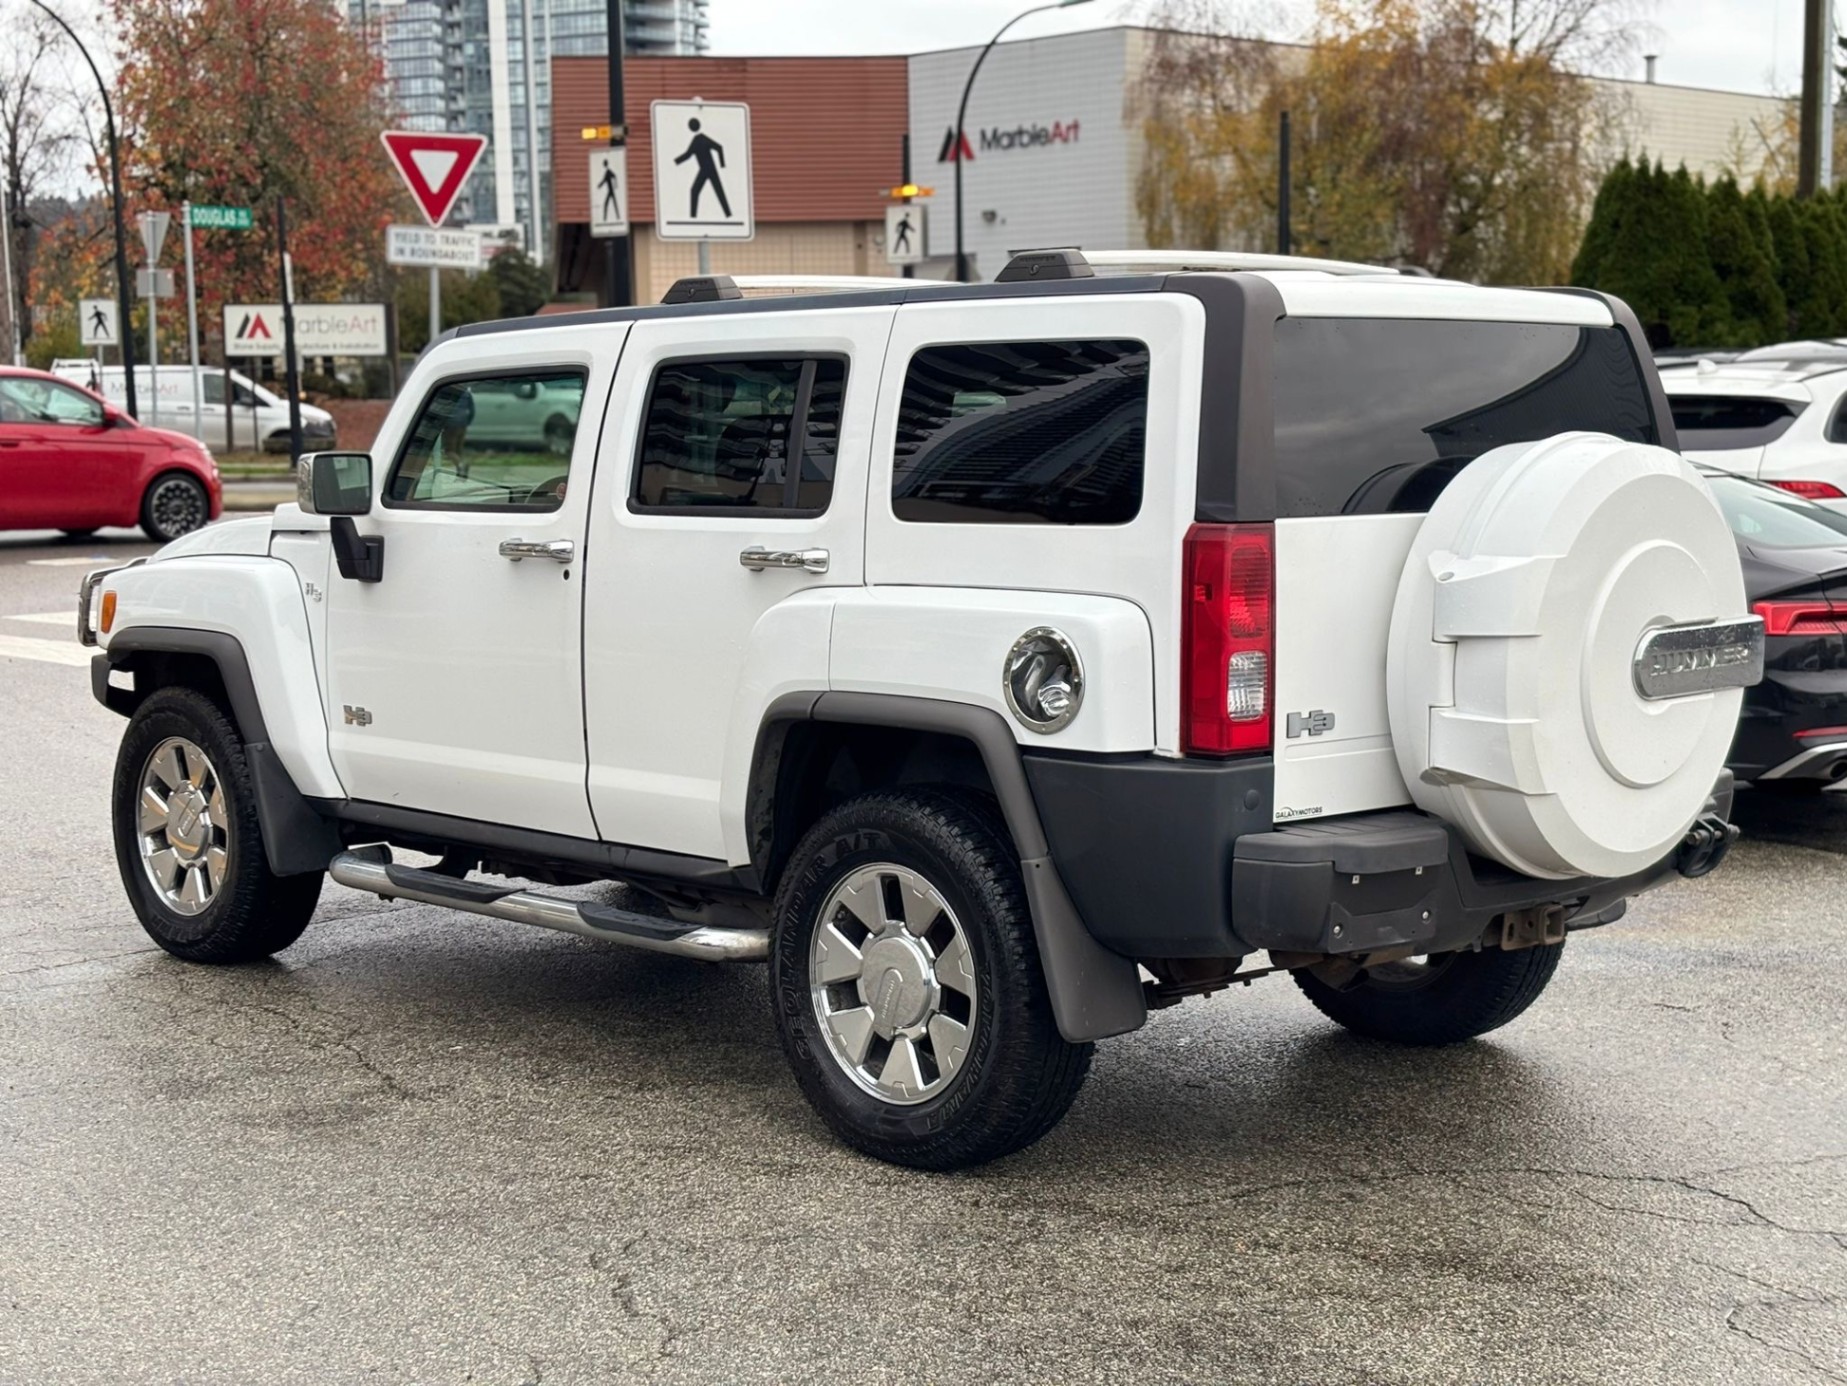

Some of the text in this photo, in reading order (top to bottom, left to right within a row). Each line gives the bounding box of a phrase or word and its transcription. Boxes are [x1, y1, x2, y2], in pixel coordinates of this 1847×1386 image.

[981, 120, 1079, 150] MarbleArt
[193, 207, 236, 226] DOUGLAS
[395, 231, 421, 245] YIELD
[440, 234, 476, 248] TRAFFIC
[411, 247, 476, 261] ROUNDABOUT
[1650, 643, 1750, 677] HUMMER
[343, 705, 372, 727] H3
[1286, 709, 1336, 739] H3
